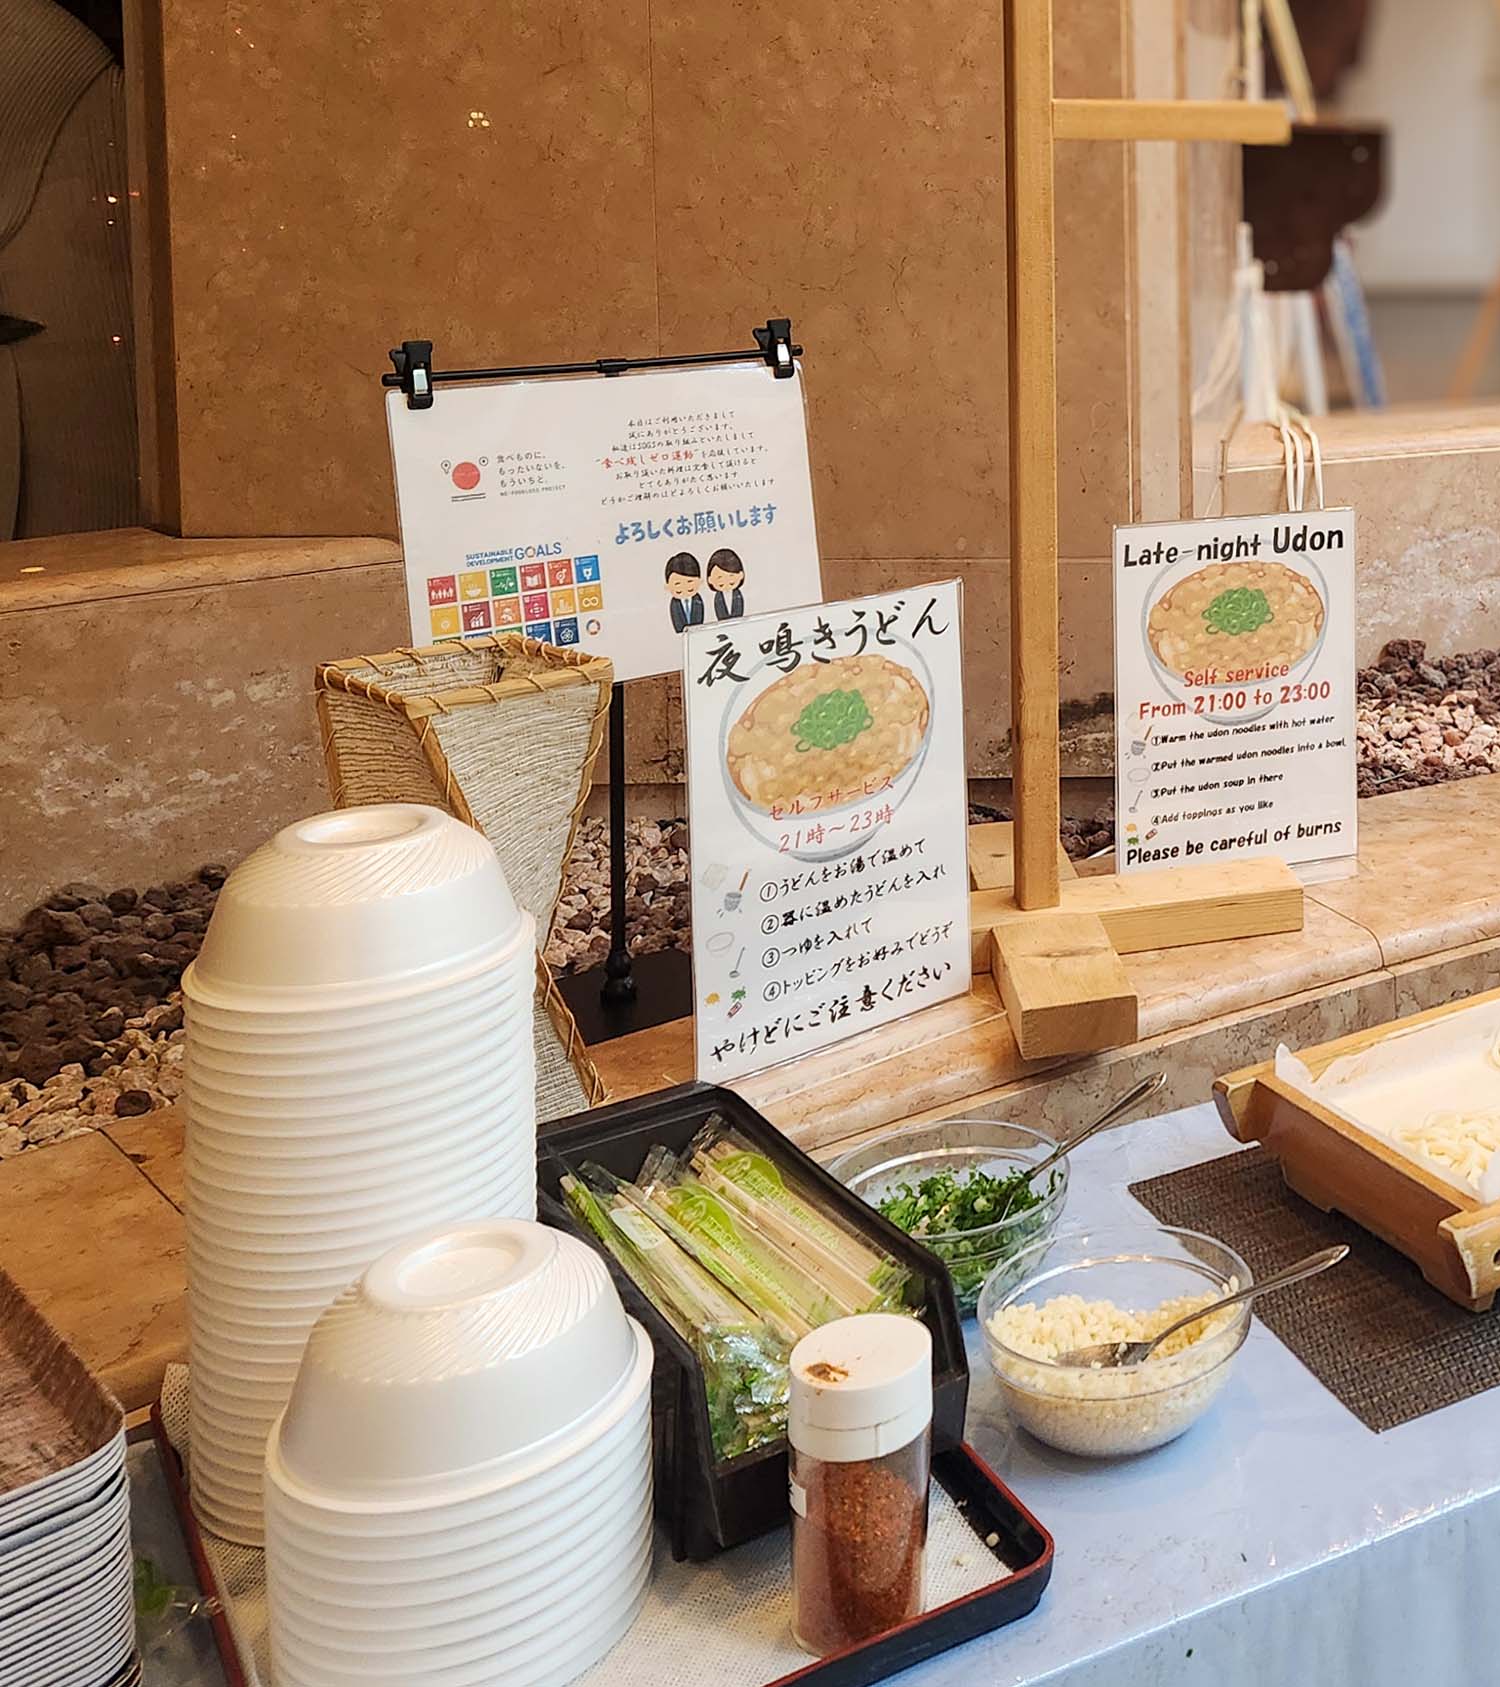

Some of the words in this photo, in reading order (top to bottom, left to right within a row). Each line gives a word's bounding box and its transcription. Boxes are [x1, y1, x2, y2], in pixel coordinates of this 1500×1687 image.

[615, 503, 777, 545] よろしくお願いします
[465, 549, 513, 560] SUSTAINABLE
[466, 556, 513, 567] DEVELOPMENT
[514, 542, 562, 560] GOALS
[1123, 534, 1262, 567] Late-night
[1272, 525, 1344, 553] Udon
[697, 598, 949, 687] 夜鳴きうどん
[1184, 670, 1217, 688] Self
[1226, 662, 1289, 682] service
[1139, 701, 1187, 720] From
[1193, 691, 1246, 713] 21:00
[1253, 689, 1273, 705] to
[1280, 681, 1330, 702] 23:00
[1189, 731, 1205, 740] the
[1207, 728, 1230, 738] udon
[1231, 724, 1267, 735] noodles
[1269, 720, 1289, 730] with
[1291, 717, 1306, 727] hot
[1309, 715, 1335, 725] water
[1180, 758, 1196, 768] the
[1198, 752, 1234, 765] warmed
[1236, 750, 1258, 760] udon
[1261, 746, 1295, 757] noodles
[1297, 742, 1316, 752] into
[769, 776, 894, 821] セルフサービス
[1180, 784, 1195, 794] the
[1198, 781, 1220, 791] udon
[1223, 778, 1245, 788] soup
[1247, 776, 1256, 785] in
[1259, 772, 1284, 783] there
[779, 804, 895, 853] 21時〜23時
[1182, 808, 1223, 821] toppings
[1225, 806, 1236, 814] as
[1239, 804, 1255, 814] you
[1257, 799, 1274, 811] like
[1126, 845, 1179, 865] Please
[1185, 839, 1204, 855] be
[1210, 829, 1268, 852] careful
[1274, 825, 1292, 842] of
[1297, 820, 1342, 838] burns
[760, 838, 926, 902] ①うどんをお湯で温めて
[761, 918, 873, 968] ③つゆを入れて
[763, 921, 953, 1001] ④トッピングをお好みでどうぞ
[710, 962, 952, 1062] やけどにご注意ください
